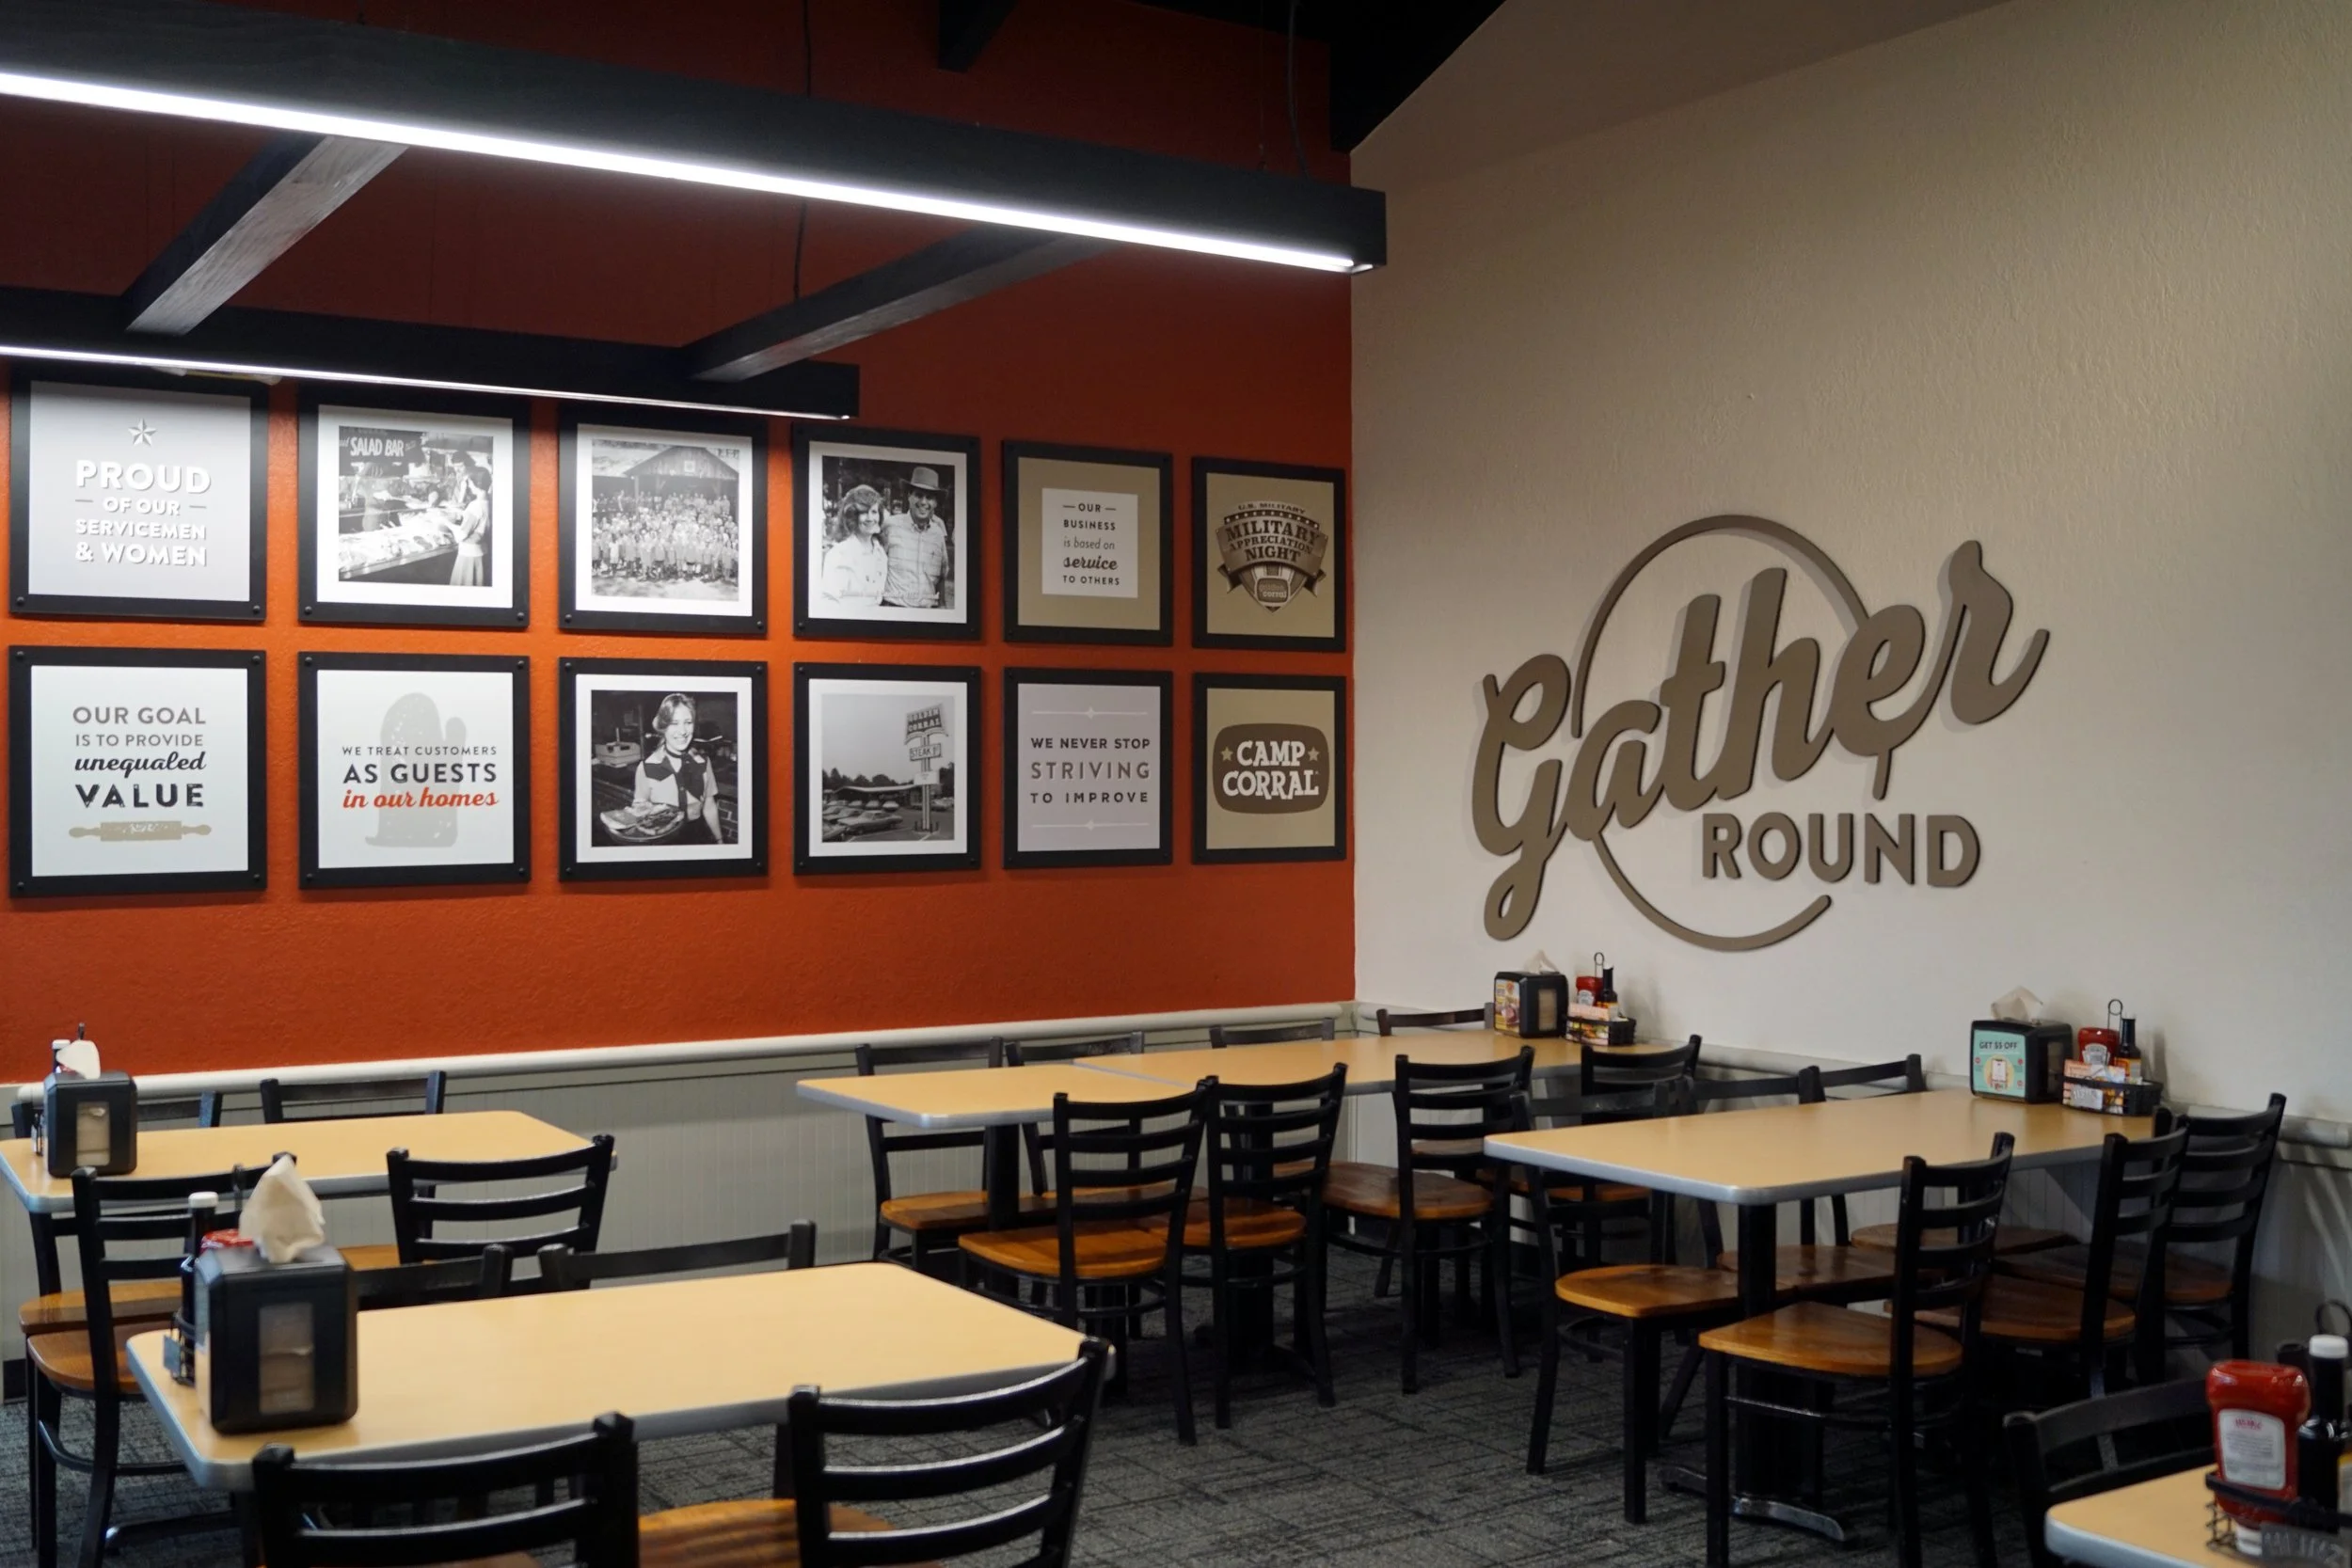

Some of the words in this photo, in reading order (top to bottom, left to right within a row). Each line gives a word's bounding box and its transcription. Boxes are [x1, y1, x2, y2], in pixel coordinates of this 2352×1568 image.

[350, 436, 383, 456] SALAD
[385, 438, 405, 457] BAR
[76, 459, 212, 494] PROUD
[103, 497, 132, 513] OF
[136, 498, 181, 515] OUR
[1078, 503, 1101, 513] OUR
[75, 518, 207, 540] SERVICEMEN
[1063, 519, 1116, 531] BUSINESS
[1225, 520, 1319, 545] MILITARY
[1063, 536, 1072, 548] is
[1073, 536, 1101, 550] based
[1104, 542, 1115, 550] on
[1230, 535, 1313, 555] APPRECIATION
[75, 542, 93, 562] &
[101, 542, 207, 566] WOMEN
[1063, 555, 1119, 571] service
[1245, 546, 1301, 562] NIGHT
[1063, 575, 1075, 584] TO
[1080, 576, 1120, 586] OTHERS
[72, 707, 129, 724] OUR
[137, 707, 206, 724] GOAL
[75, 734, 90, 747] IS
[96, 734, 119, 747] TO
[126, 734, 203, 747] PROVIDE
[1031, 737, 1054, 749] WE
[1060, 737, 1107, 749] NEVER
[1114, 737, 1151, 750] STOP
[1471, 539, 2050, 942] Gather
[342, 746, 361, 755] WE
[368, 746, 408, 755] TREAT
[415, 746, 497, 755] CUSTOMERS
[1236, 740, 1306, 767] CAMP
[74, 751, 207, 779] unequaled
[343, 764, 378, 784] AS
[391, 763, 497, 784] GUESTS
[1031, 762, 1150, 780] STRIVING
[1223, 769, 1320, 800] CORRAL
[75, 784, 204, 808] VALUE
[342, 789, 369, 808] in
[373, 794, 417, 808] our
[419, 786, 499, 807] homes
[1030, 793, 1053, 803] TO
[1066, 792, 1148, 803] IMPROVE
[1702, 812, 1980, 887] ROUND
[1979, 1041, 1993, 1050] GET
[2004, 1041, 2017, 1050] OFF
